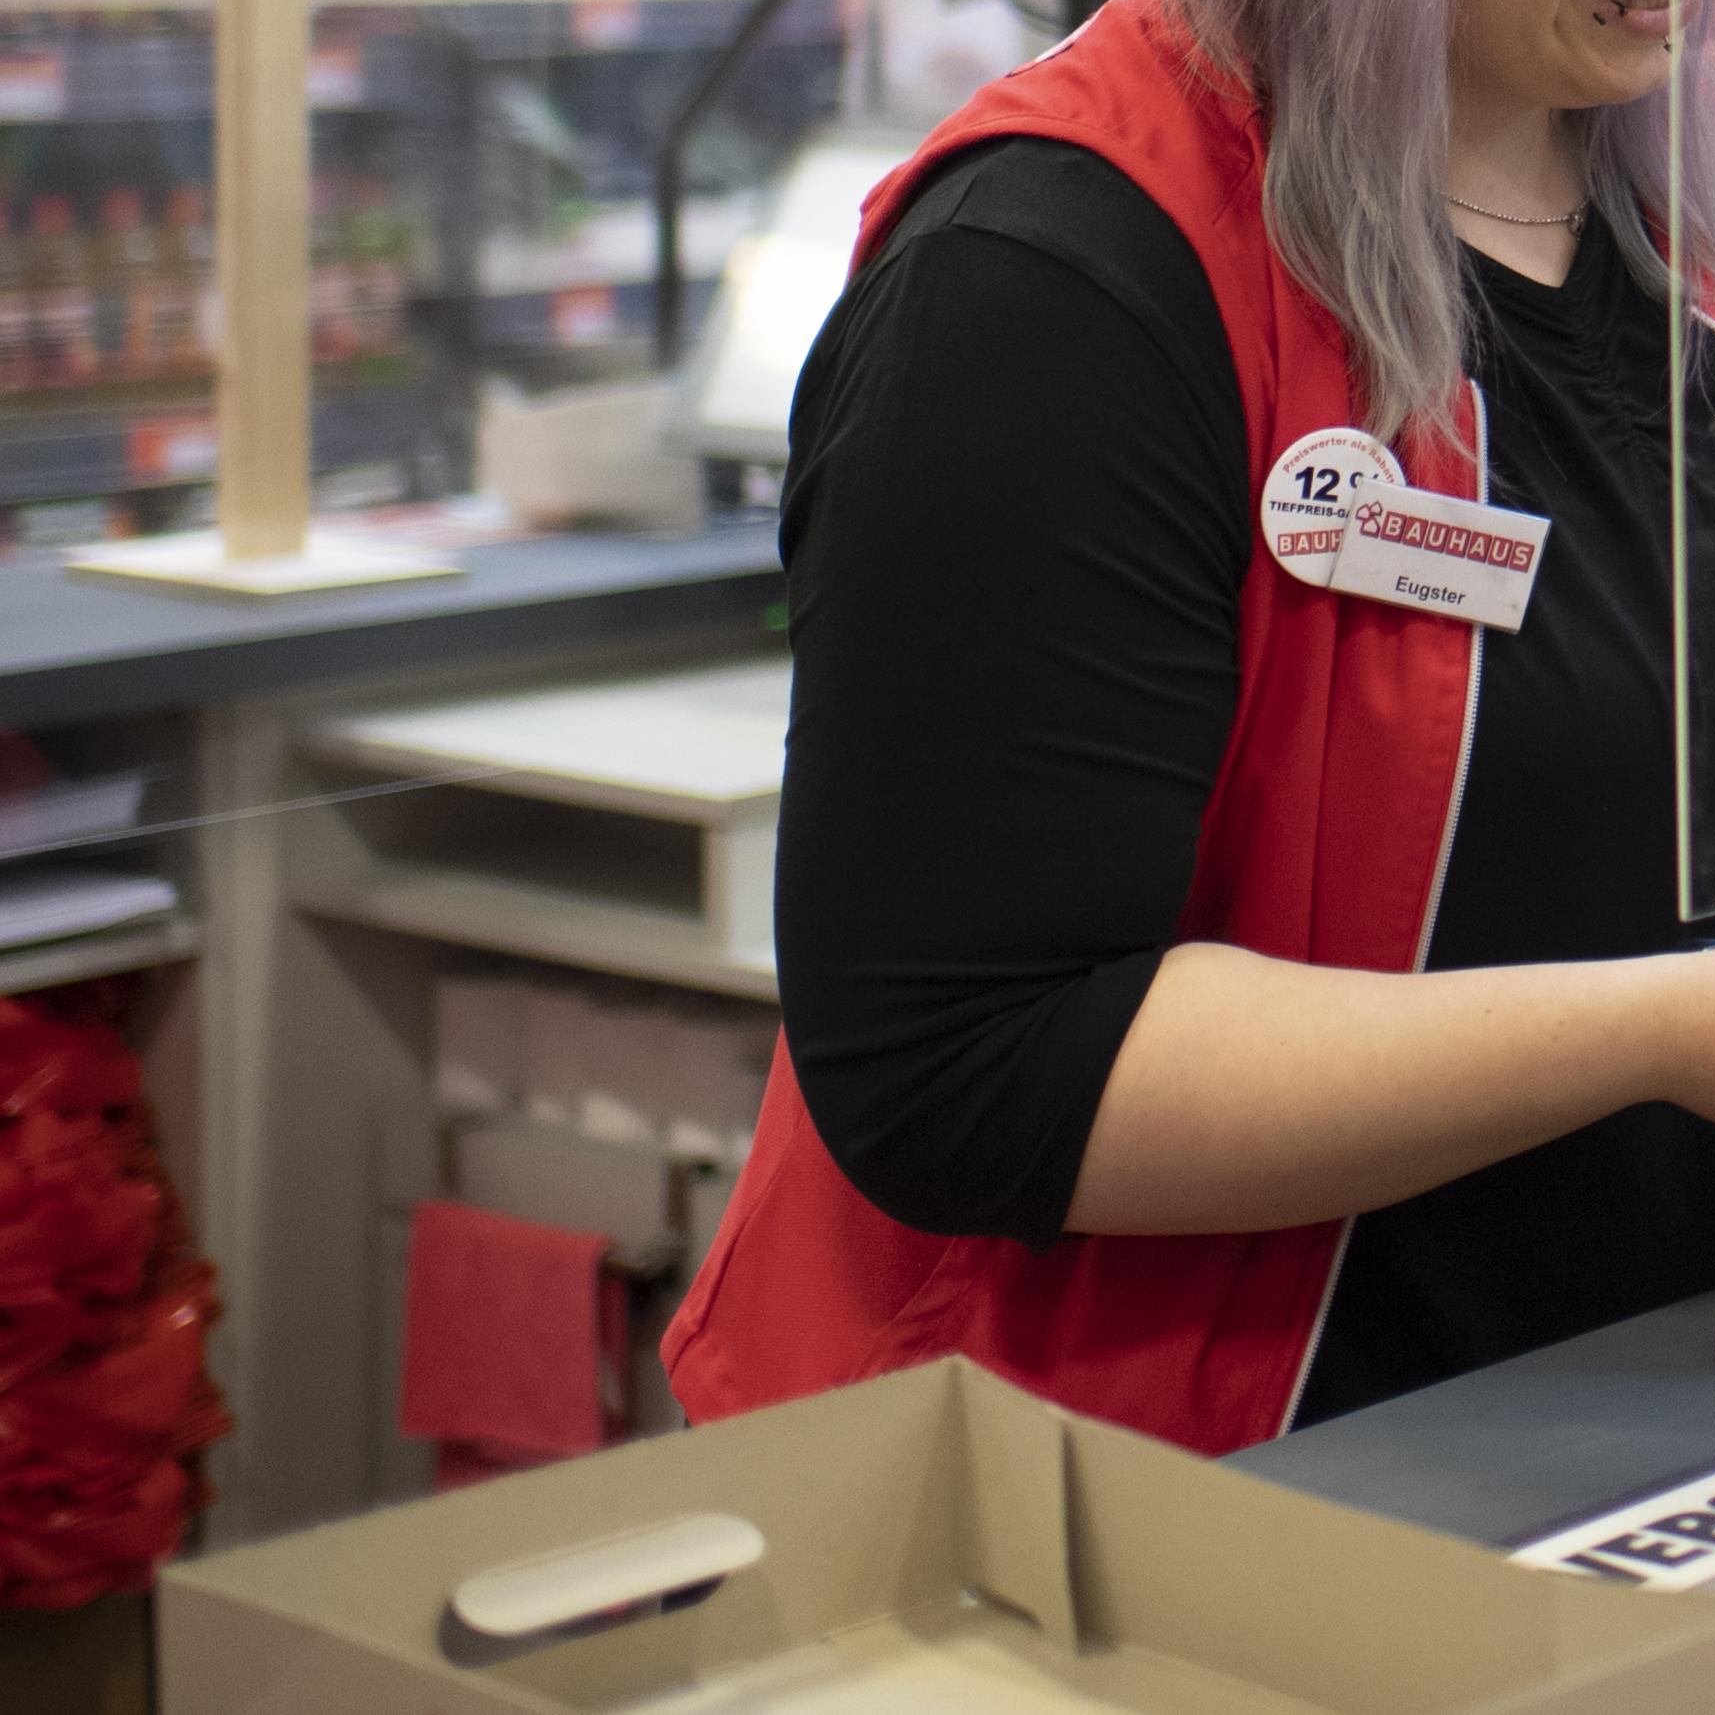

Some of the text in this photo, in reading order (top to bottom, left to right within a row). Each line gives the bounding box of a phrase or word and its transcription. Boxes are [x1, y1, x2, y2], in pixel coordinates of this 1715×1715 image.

[1282, 437, 1347, 474] Preiswerter
[1350, 440, 1367, 452] als
[1294, 466, 1340, 503] 12
[1382, 512, 1534, 571] BAUHAUS
[1395, 575, 1466, 606] Eugster
